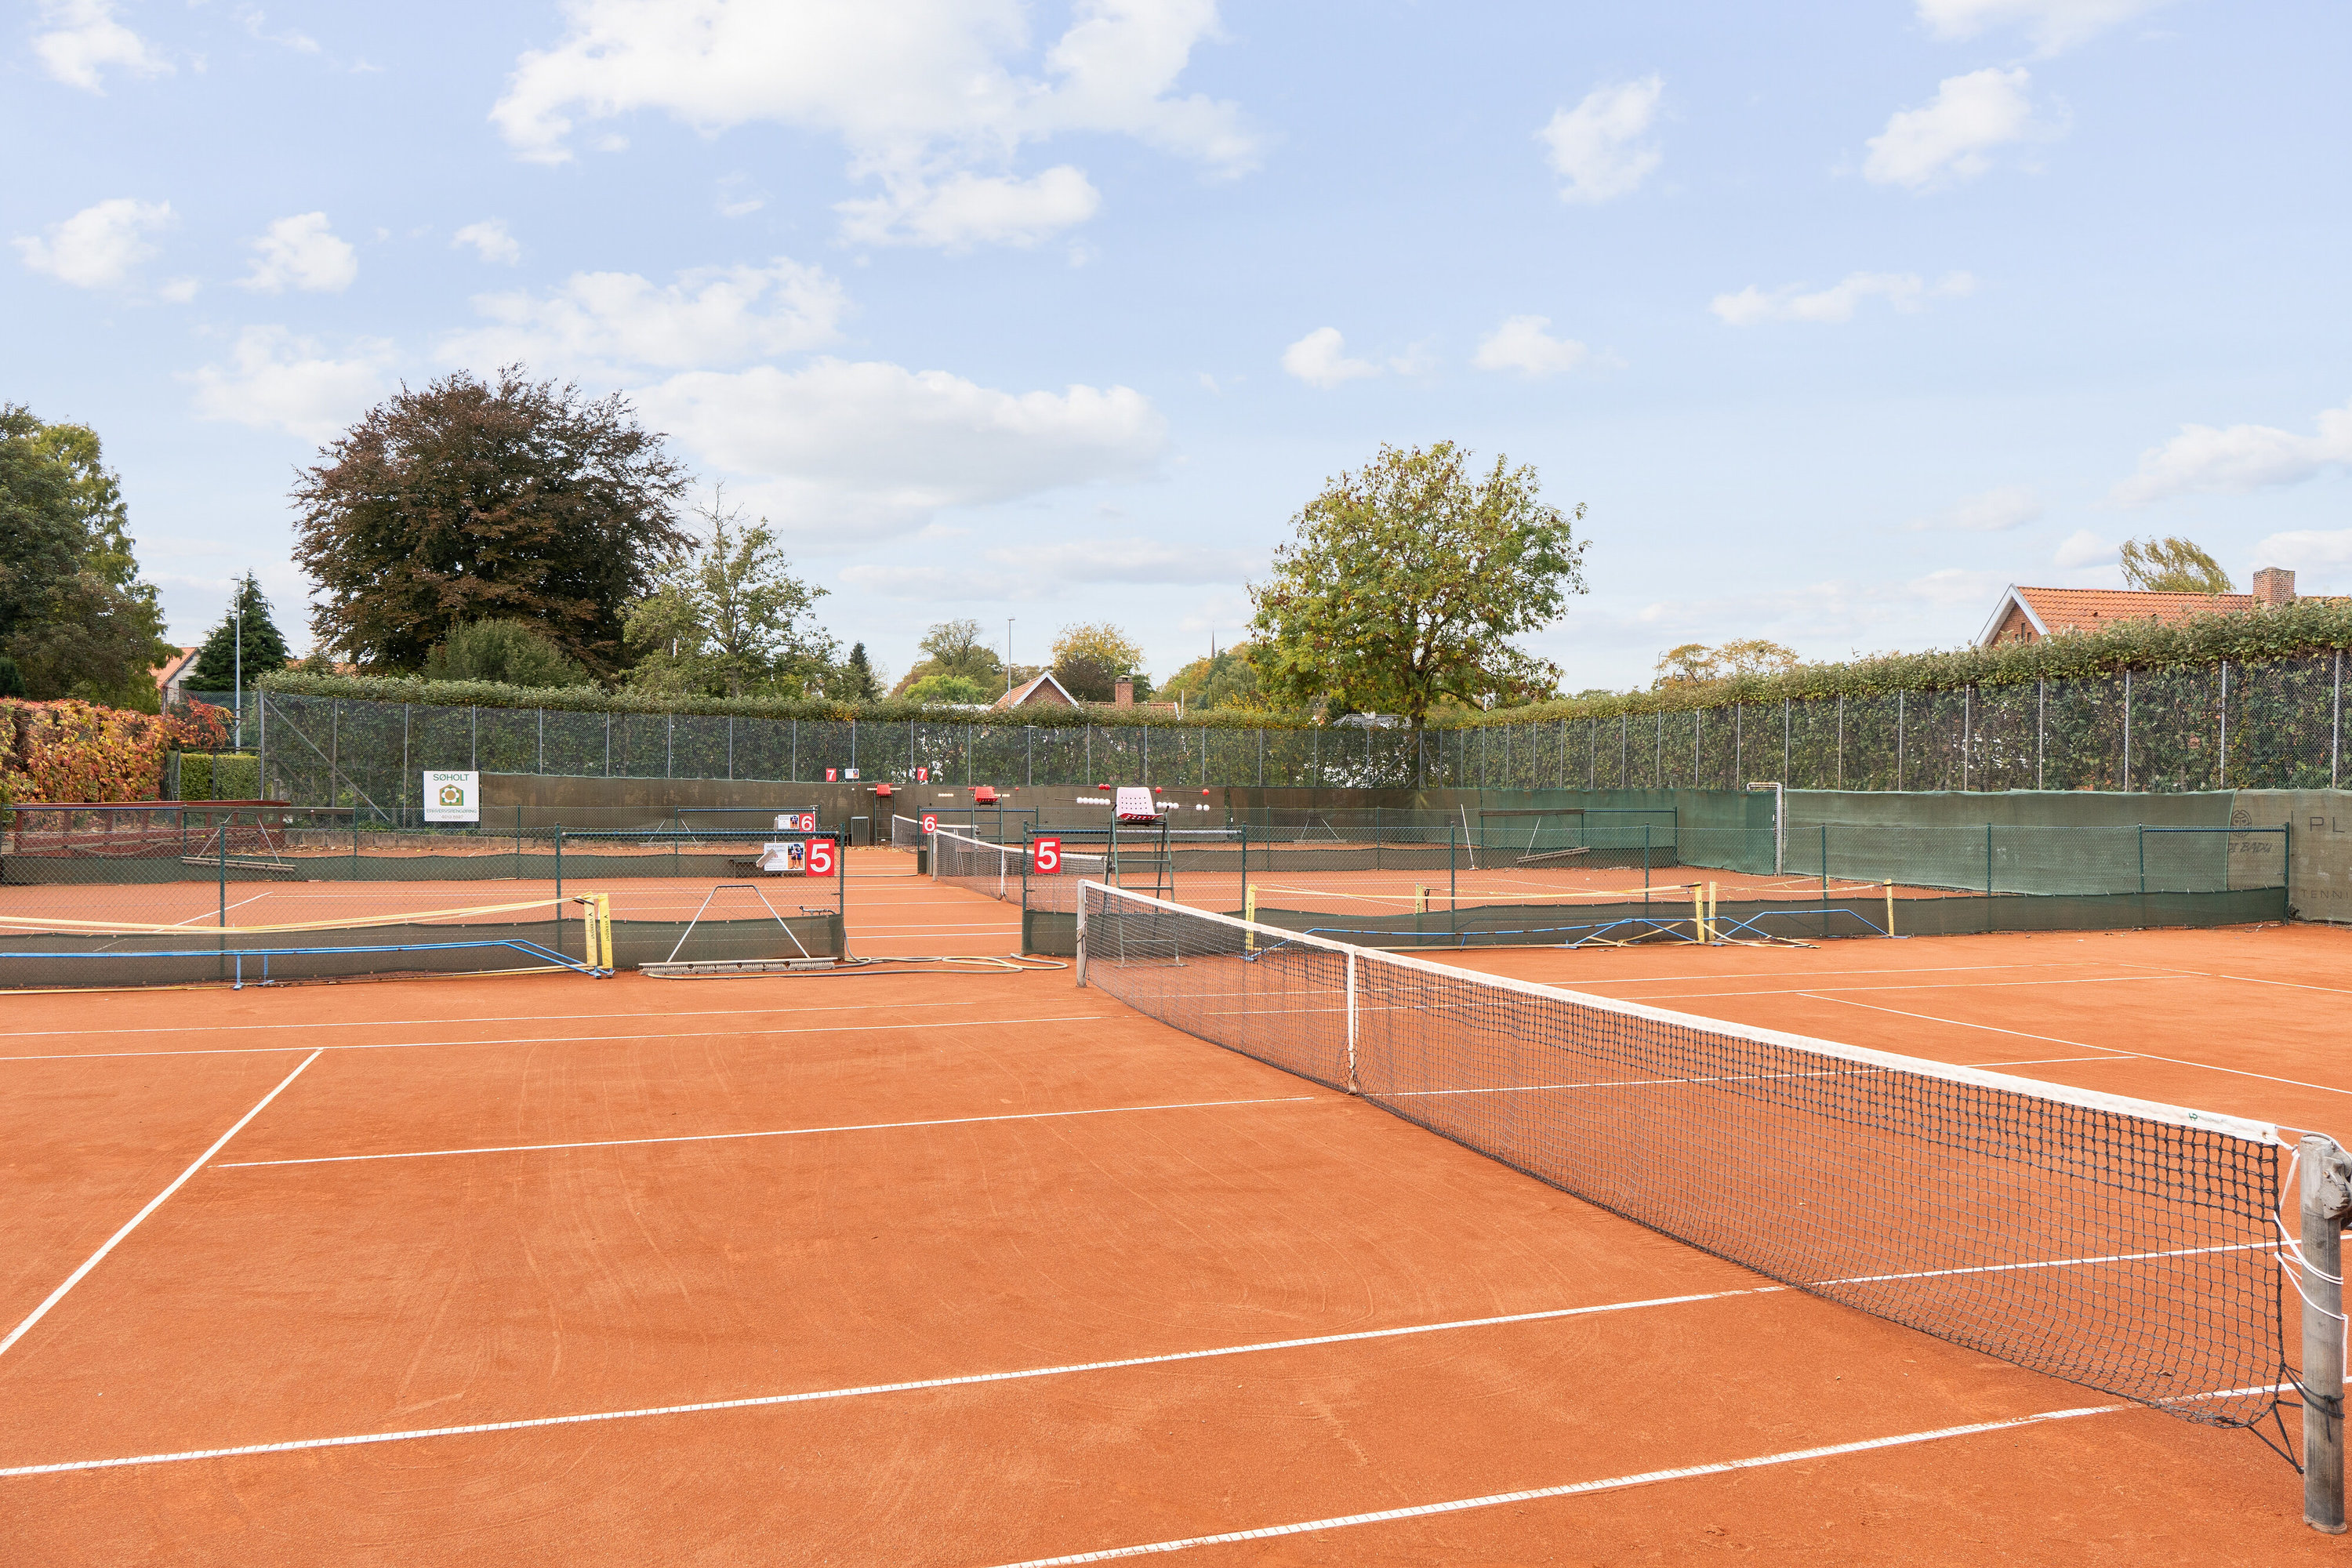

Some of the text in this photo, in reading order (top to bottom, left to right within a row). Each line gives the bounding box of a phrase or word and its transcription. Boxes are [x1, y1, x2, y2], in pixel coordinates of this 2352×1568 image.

[828, 770, 834, 780] 7
[919, 769, 926, 779] 7
[801, 816, 812, 830] 6
[924, 817, 935, 831] 6
[811, 844, 831, 872] 5
[1038, 842, 1057, 869] 5
